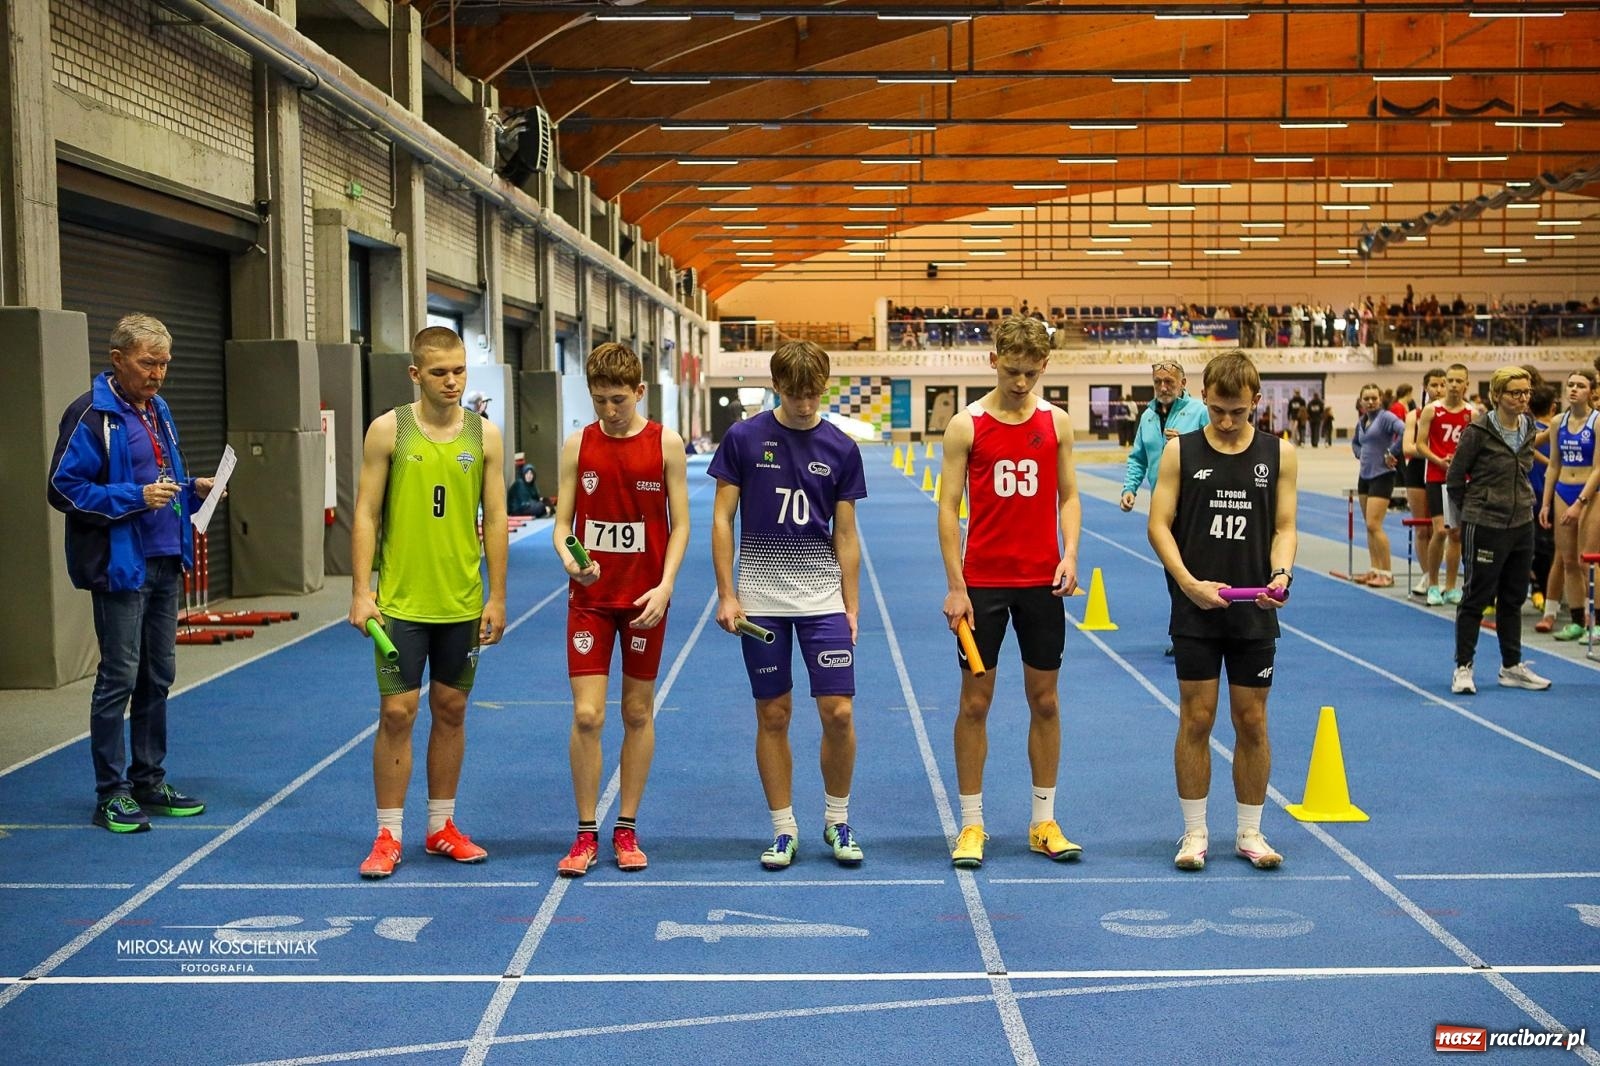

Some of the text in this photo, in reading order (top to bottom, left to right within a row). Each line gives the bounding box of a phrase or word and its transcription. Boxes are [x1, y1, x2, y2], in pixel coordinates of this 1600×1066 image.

[1441, 423, 1462, 444] 76
[994, 459, 1038, 497] 63
[1193, 468, 1214, 480] 4F
[433, 485, 446, 518] 9
[1209, 499, 1252, 510] RUDA ŚLĄSKA
[1225, 489, 1247, 499] POGOŃ
[775, 487, 810, 525] 70
[594, 523, 635, 548] 719
[1209, 514, 1247, 540] 412
[819, 650, 853, 668] Sprint
